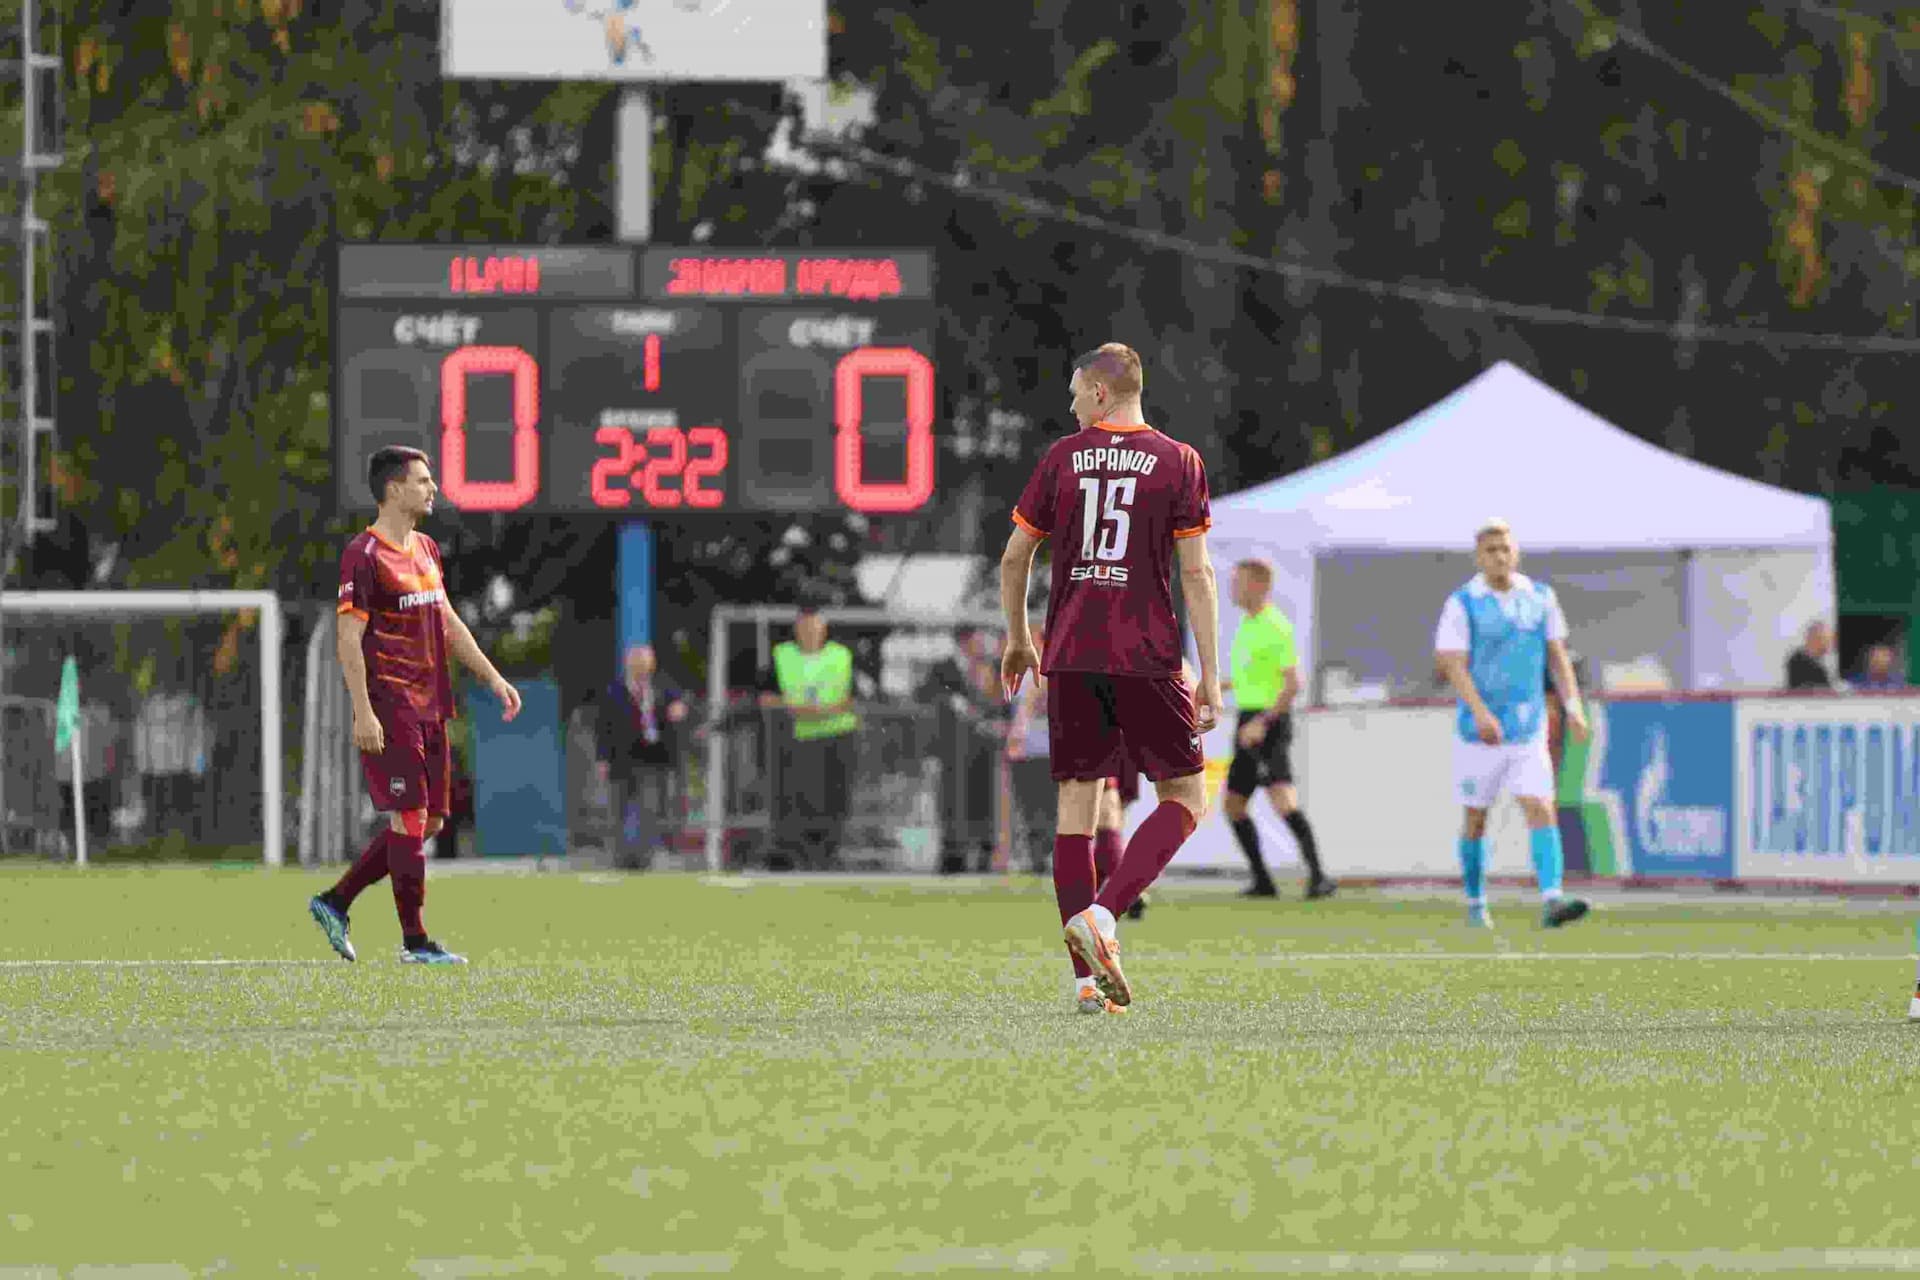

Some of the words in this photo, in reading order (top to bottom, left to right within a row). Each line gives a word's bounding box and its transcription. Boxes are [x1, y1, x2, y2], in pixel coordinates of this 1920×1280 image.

[643, 333, 661, 392] 1
[441, 345, 539, 512] 0
[590, 426, 729, 508] 2:22
[834, 345, 935, 512] 0
[1072, 448, 1158, 475] АБРАМОВ
[1079, 477, 1137, 560] 15
